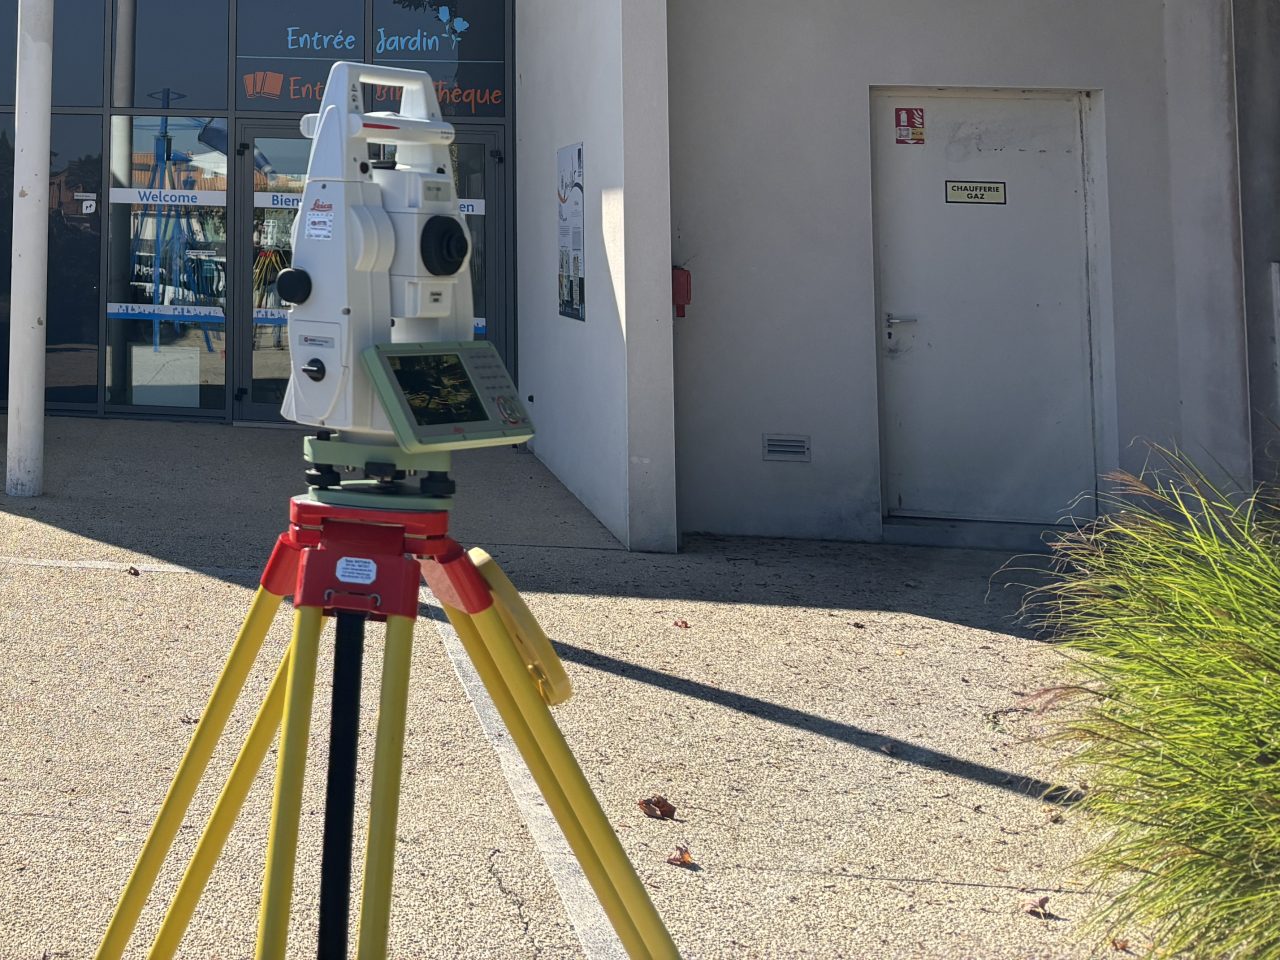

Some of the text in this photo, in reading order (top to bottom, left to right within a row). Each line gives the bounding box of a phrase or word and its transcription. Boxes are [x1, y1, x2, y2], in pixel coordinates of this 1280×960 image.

[287, 26, 440, 54] Entrée Jardin
[951, 185, 1000, 193] CHAUFFERIE
[138, 190, 198, 204] Welcome
